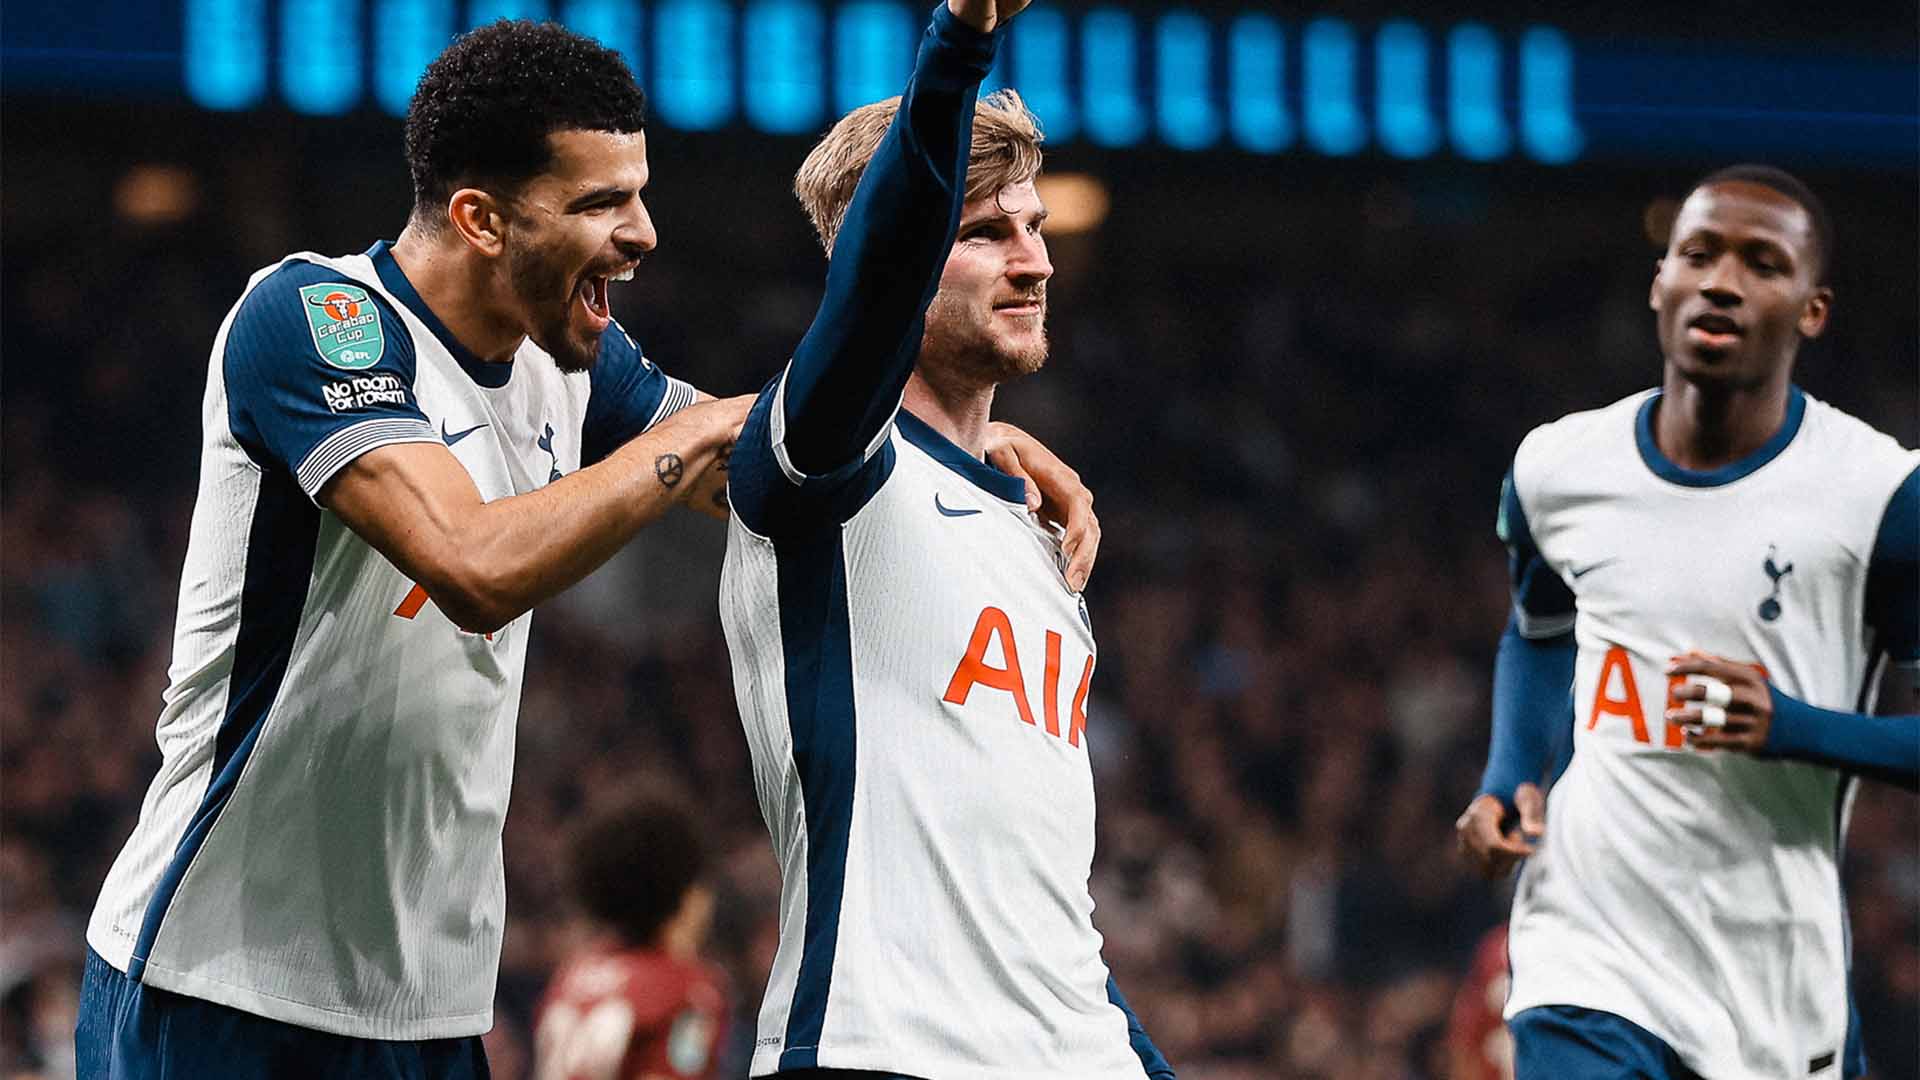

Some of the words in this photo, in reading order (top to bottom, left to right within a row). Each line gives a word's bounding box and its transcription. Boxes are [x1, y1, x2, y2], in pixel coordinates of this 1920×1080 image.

[318, 313, 375, 338] Carabao
[336, 329, 363, 343] Cup
[322, 382, 351, 401] No
[352, 376, 399, 393] room
[327, 395, 355, 413] for
[355, 390, 406, 407] racism
